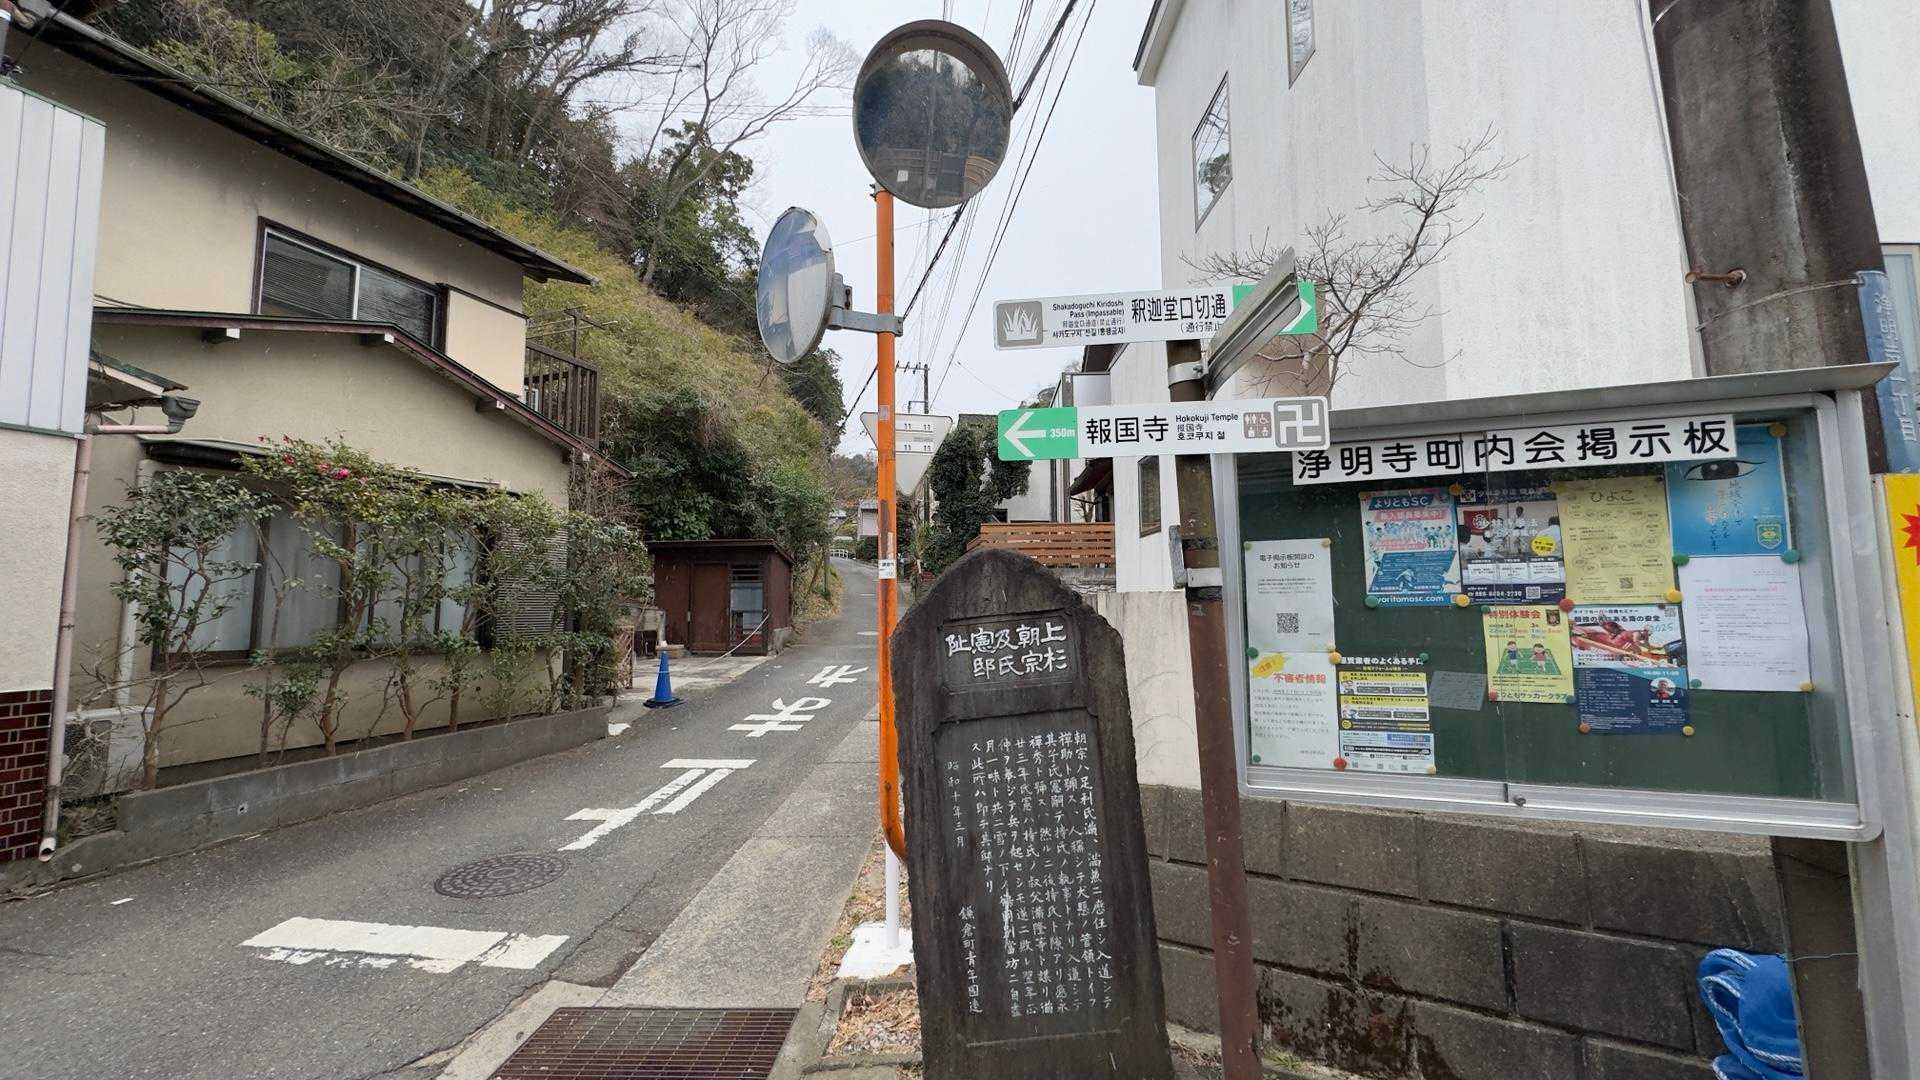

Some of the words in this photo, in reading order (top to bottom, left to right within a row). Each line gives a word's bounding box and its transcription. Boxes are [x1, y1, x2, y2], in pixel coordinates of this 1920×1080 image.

[1053, 301, 1095, 311] Shakadoguchi
[1097, 299, 1124, 308] Kiridoshi
[1131, 294, 1227, 324] 釈迦堂口切通
[1086, 308, 1125, 318] (Impassable)
[1175, 414, 1209, 426] Hokokuji
[1211, 412, 1239, 424] Temple
[1049, 427, 1076, 440] 350m
[1086, 415, 1169, 445] 報国寺
[1298, 419, 1731, 481] 浄明寺町内会掲示板
